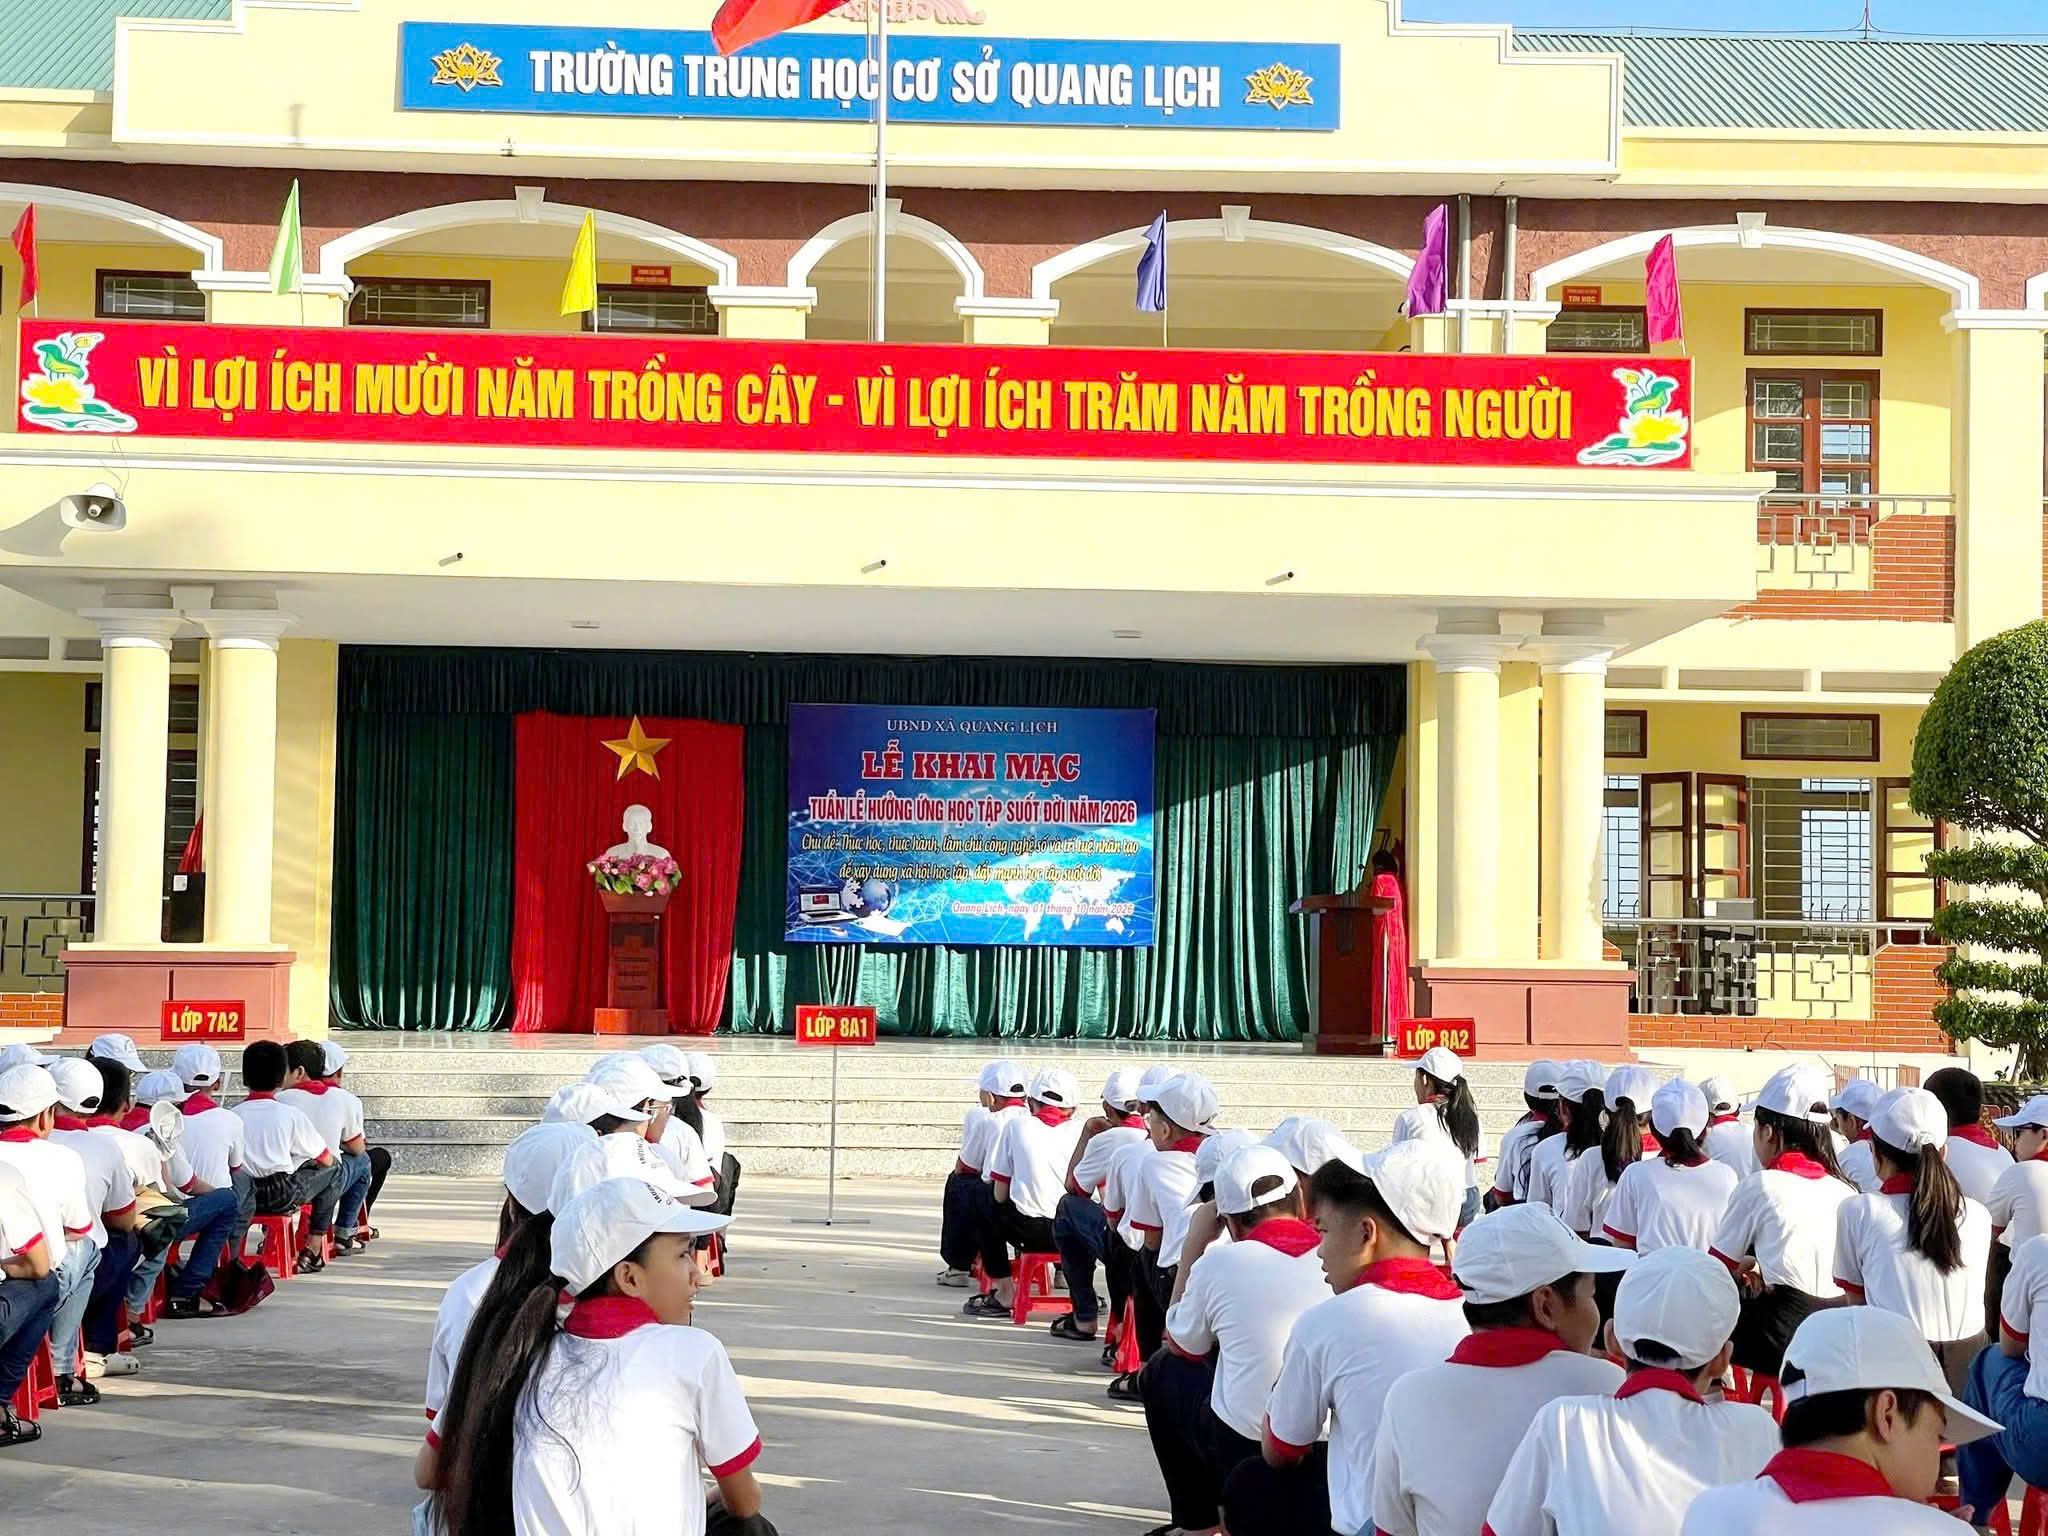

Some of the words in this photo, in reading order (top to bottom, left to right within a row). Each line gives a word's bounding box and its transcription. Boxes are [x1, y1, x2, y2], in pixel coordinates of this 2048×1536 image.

[530, 42, 673, 96] TRƯỜNG
[683, 55, 800, 99] TRUNG
[811, 58, 879, 109] HỌC
[892, 58, 941, 102] CƠ
[952, 45, 1001, 103] SỞ
[1012, 62, 1133, 108] QUANG
[1145, 66, 1220, 116] LỊCH
[138, 346, 179, 408] VÌ
[192, 358, 256, 422] LỢI
[271, 348, 342, 413] ÍCH
[355, 352, 464, 416] MƯỜI
[477, 357, 575, 419] NĂM
[587, 353, 723, 423] TRỒNG
[736, 363, 817, 425] CÂY
[857, 366, 895, 426] VÌ
[909, 373, 971, 438] LỢI
[984, 366, 1052, 430] ÍCH
[1064, 371, 1178, 433] TRĂM
[1191, 373, 1286, 434] NĂM
[1298, 369, 1431, 438] TRỒNG
[1445, 376, 1572, 440] NGƯỜI
[887, 719, 931, 731] UBND
[960, 720, 1014, 734] QUANG
[1020, 722, 1057, 735] LỊCH
[862, 739, 903, 779] LỄ
[912, 752, 996, 780] KHAI
[1005, 753, 1080, 787] MẠC
[809, 789, 846, 821] TUẦN
[848, 788, 865, 821] LỄ
[916, 794, 945, 822] ỨNG
[947, 797, 974, 827] HỌC
[978, 794, 1003, 827] TẬP
[1006, 792, 1040, 824] SUỐT
[1043, 794, 1068, 824] ĐỜI
[1069, 795, 1101, 825] NĂM
[1102, 800, 1137, 825] 2026
[984, 836, 1008, 855] công
[1010, 836, 1034, 856] nghệ
[1035, 835, 1048, 852] số
[171, 1005, 203, 1032] LỚP
[207, 1011, 239, 1032] 7A2
[805, 1010, 836, 1038] LỚP
[840, 1016, 868, 1037] 8A1
[1406, 1024, 1436, 1050] LỚP
[1440, 1029, 1469, 1050] 8A2
